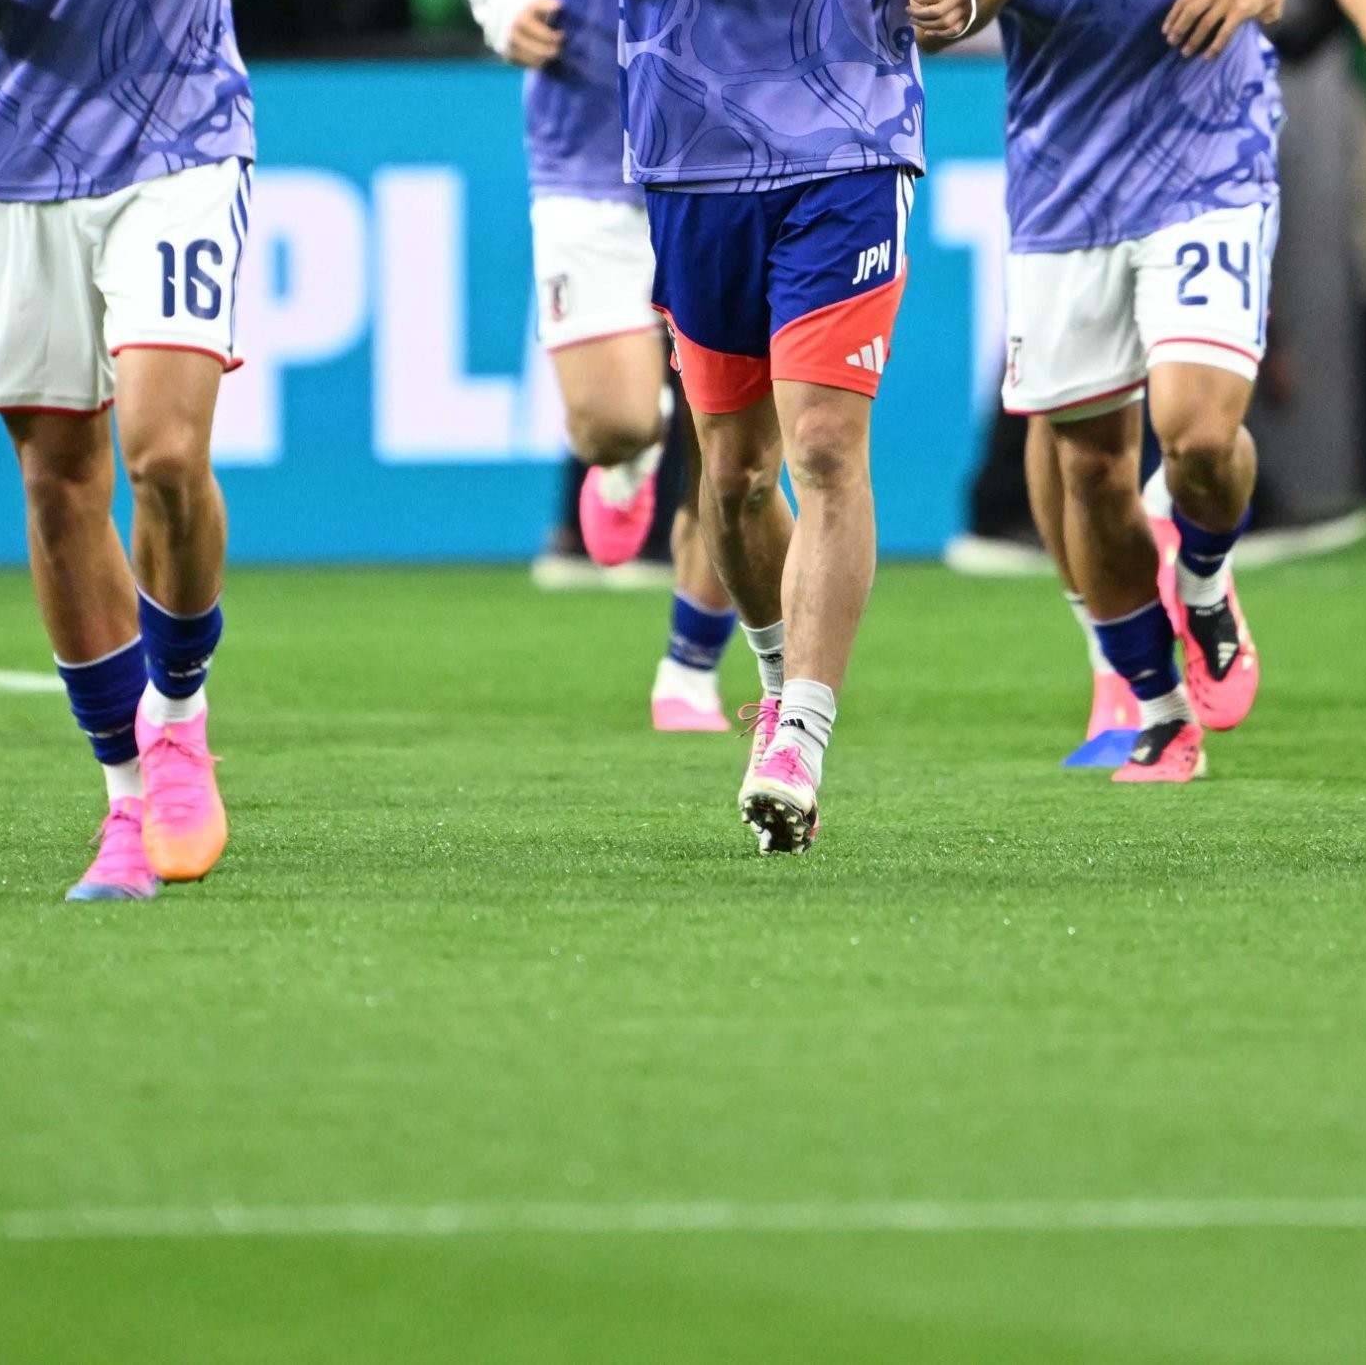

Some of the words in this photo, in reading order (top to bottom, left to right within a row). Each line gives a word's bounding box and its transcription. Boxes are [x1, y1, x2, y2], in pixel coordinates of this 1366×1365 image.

[157, 238, 223, 320] 16
[852, 239, 891, 285] JPN
[1176, 240, 1250, 310] 24
